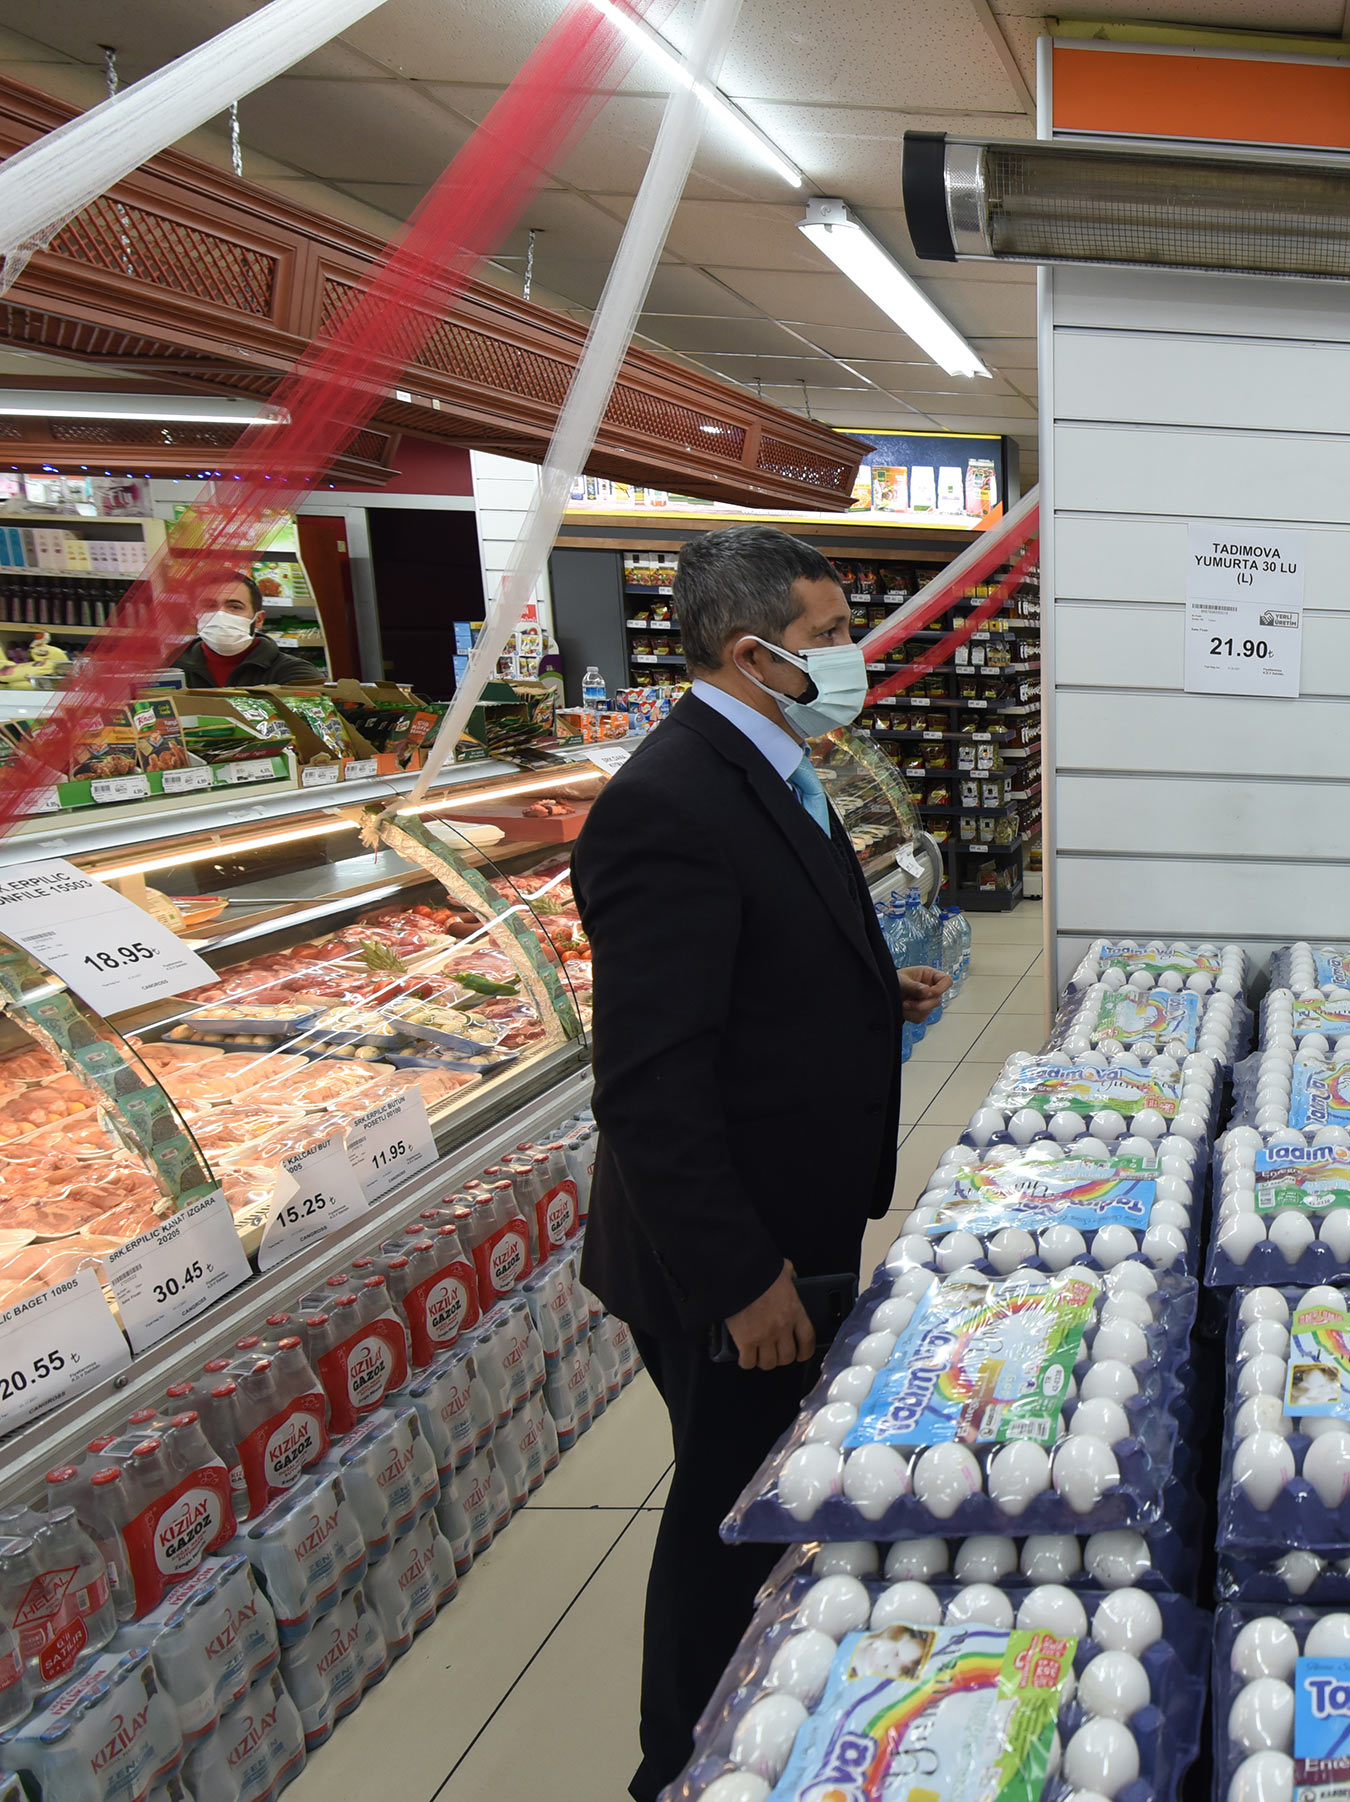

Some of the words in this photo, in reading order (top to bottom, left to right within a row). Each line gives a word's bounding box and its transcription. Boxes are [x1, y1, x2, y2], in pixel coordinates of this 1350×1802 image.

[1195, 555, 1258, 570] YUMURTA
[1263, 562, 1277, 572] 30
[1281, 563, 1297, 573] LU
[1213, 543, 1281, 559] TADIMOVA
[1237, 573, 1254, 585] (L)
[50, 879, 93, 894] 15503
[317, 1139, 331, 1152] BUT
[371, 1140, 406, 1169] 11.95
[161, 1213, 186, 1233] KANAT
[186, 1197, 216, 1217] IZGARA
[275, 1193, 327, 1228] 15.25
[550, 1210, 570, 1232] GAZOZ
[156, 1228, 181, 1245] 20205
[492, 1240, 520, 1269] KIZILAY
[495, 1252, 521, 1278] GAZOZ
[13, 1293, 49, 1317] BAGET
[50, 1279, 79, 1297] 10805
[152, 1260, 204, 1303] 30.45
[429, 1287, 458, 1317] KIZILAY
[432, 1299, 462, 1328] GAZOZ
[0, 1349, 65, 1401] 20.55
[352, 1360, 386, 1393] GAZOZ
[269, 1419, 310, 1462] KIZILAY
[273, 1435, 313, 1473] GAZOZ
[159, 1498, 209, 1547] KIZILAY
[165, 1514, 213, 1559] GAZOZ
[22, 1576, 69, 1621] HELAL
[204, 1599, 259, 1660] KIZILAY
[45, 1631, 83, 1670] SATILIR
[316, 1622, 360, 1678] KIZILAY
[90, 1705, 149, 1780] KIZILAY
[226, 1705, 280, 1767] KIZILAY
